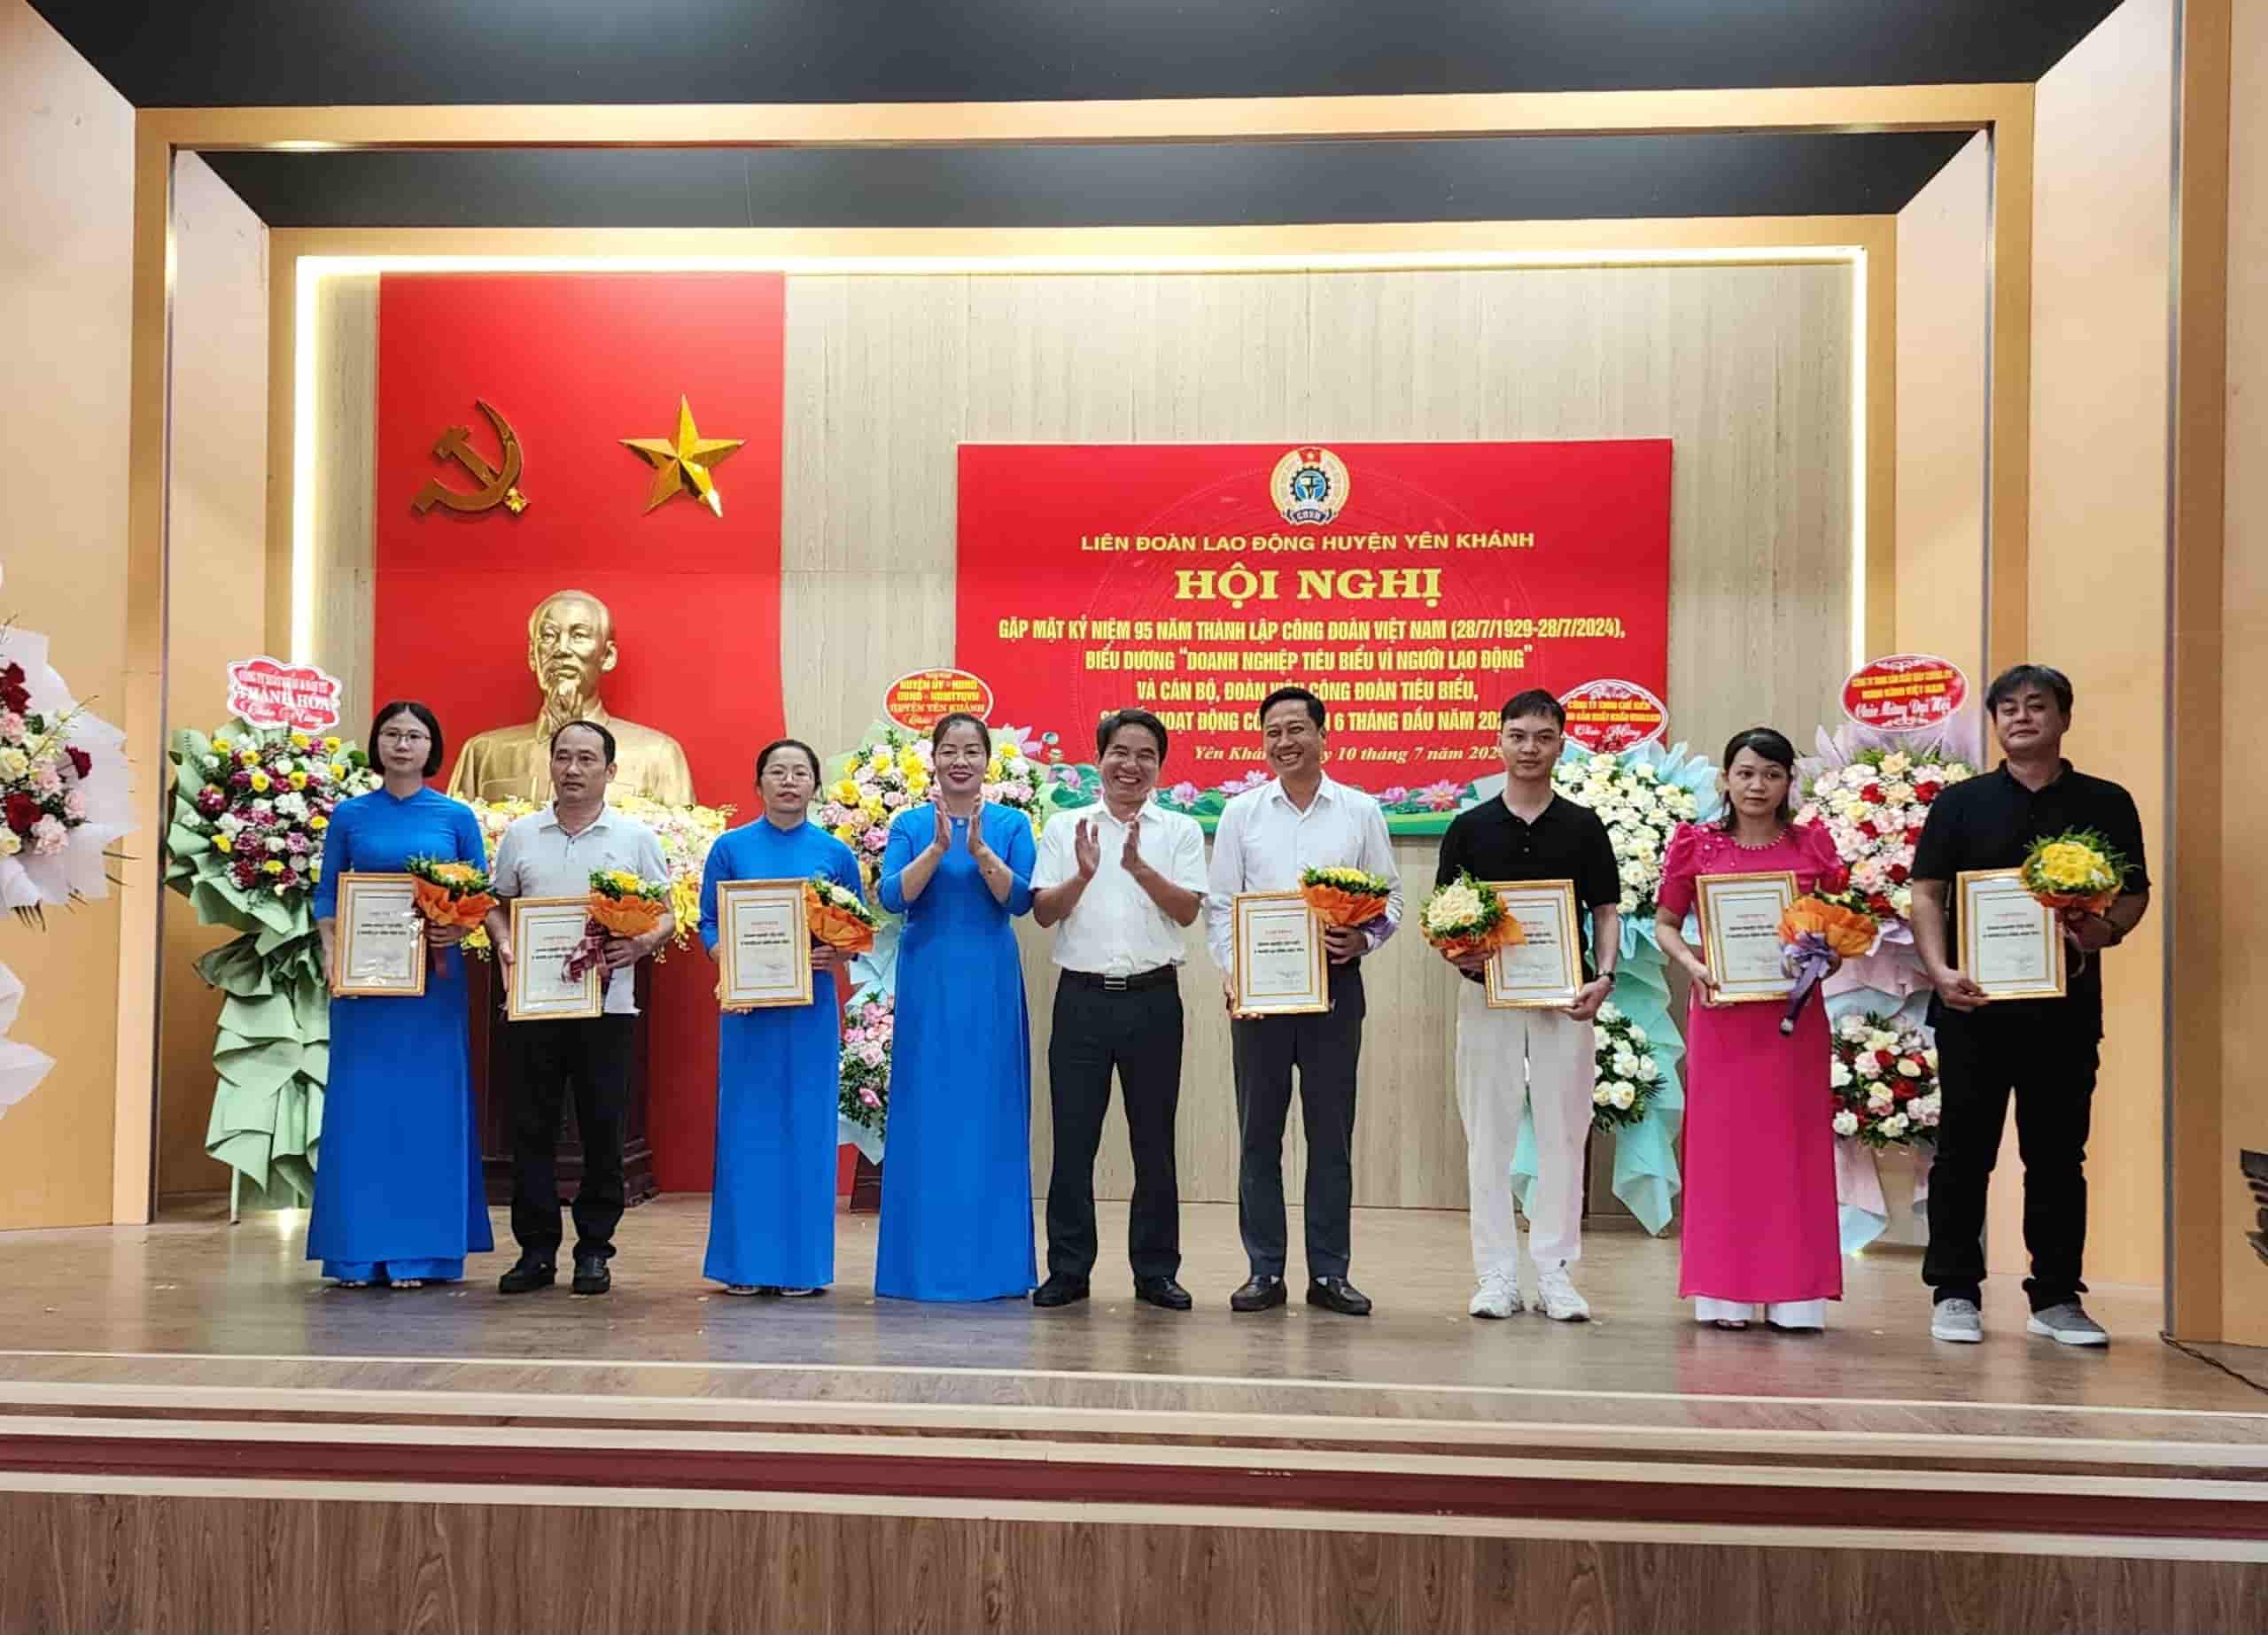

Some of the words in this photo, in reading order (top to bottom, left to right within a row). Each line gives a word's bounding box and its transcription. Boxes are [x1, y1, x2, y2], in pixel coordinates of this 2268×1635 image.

[1081, 532, 1130, 551] LIÊN
[1136, 533, 1196, 552] ĐOÀN
[1203, 536, 1247, 552] LAO
[1251, 532, 1316, 554] ĐỘNG
[1322, 531, 1397, 554] HUYỆN
[1404, 531, 1449, 549] YÊN
[1456, 530, 1534, 548] KHÁNH
[1174, 562, 1279, 609] HỘI
[1296, 568, 1442, 608] NGHỊ
[998, 616, 1029, 643] GẶP
[1032, 616, 1066, 643] MẶT
[1068, 614, 1089, 640] KỶ
[1091, 617, 1131, 642] NIỆM
[1133, 621, 1153, 641] 95
[1155, 617, 1193, 641] NĂM
[1195, 617, 1247, 641] THÀNH
[1248, 617, 1279, 645] LẬP
[1281, 617, 1324, 641] CÔNG
[1326, 616, 1371, 641] ĐOÀN
[1372, 616, 1408, 644] VIỆT
[1409, 619, 1447, 640] NAM
[1450, 617, 1626, 641] (28/7/1929-28/7/2024),
[1084, 639, 1121, 670] BIỂU
[1122, 649, 1176, 671] DƯƠNG
[1241, 647, 1299, 676] NGHIỆP
[1301, 647, 1336, 671] TIÊU
[1339, 644, 1375, 671] BIỂU
[1377, 647, 1394, 671] VÌ
[1395, 646, 1445, 670] NGƯỜI
[1447, 649, 1478, 670] LAO
[1136, 678, 1157, 701] VÀ
[1159, 678, 1192, 701] CÁN
[1194, 678, 1221, 705] BỘ,
[1223, 678, 1268, 701] ĐOÀN
[1353, 678, 1398, 701] ĐOÀN
[1400, 677, 1435, 701] TIÊU
[1437, 672, 1479, 702] BIỂU,
[1197, 708, 1239, 734] ĐỘNG
[1333, 711, 1345, 732] 6
[1347, 708, 1400, 732] THÁNG
[1402, 705, 1435, 732] ĐẦU
[1437, 708, 1475, 731] NĂM
[1196, 746, 1223, 759] Yên
[1339, 747, 1357, 761] 10
[1361, 746, 1409, 763] tháng
[1414, 747, 1425, 760] 7
[1427, 747, 1464, 760] năm
